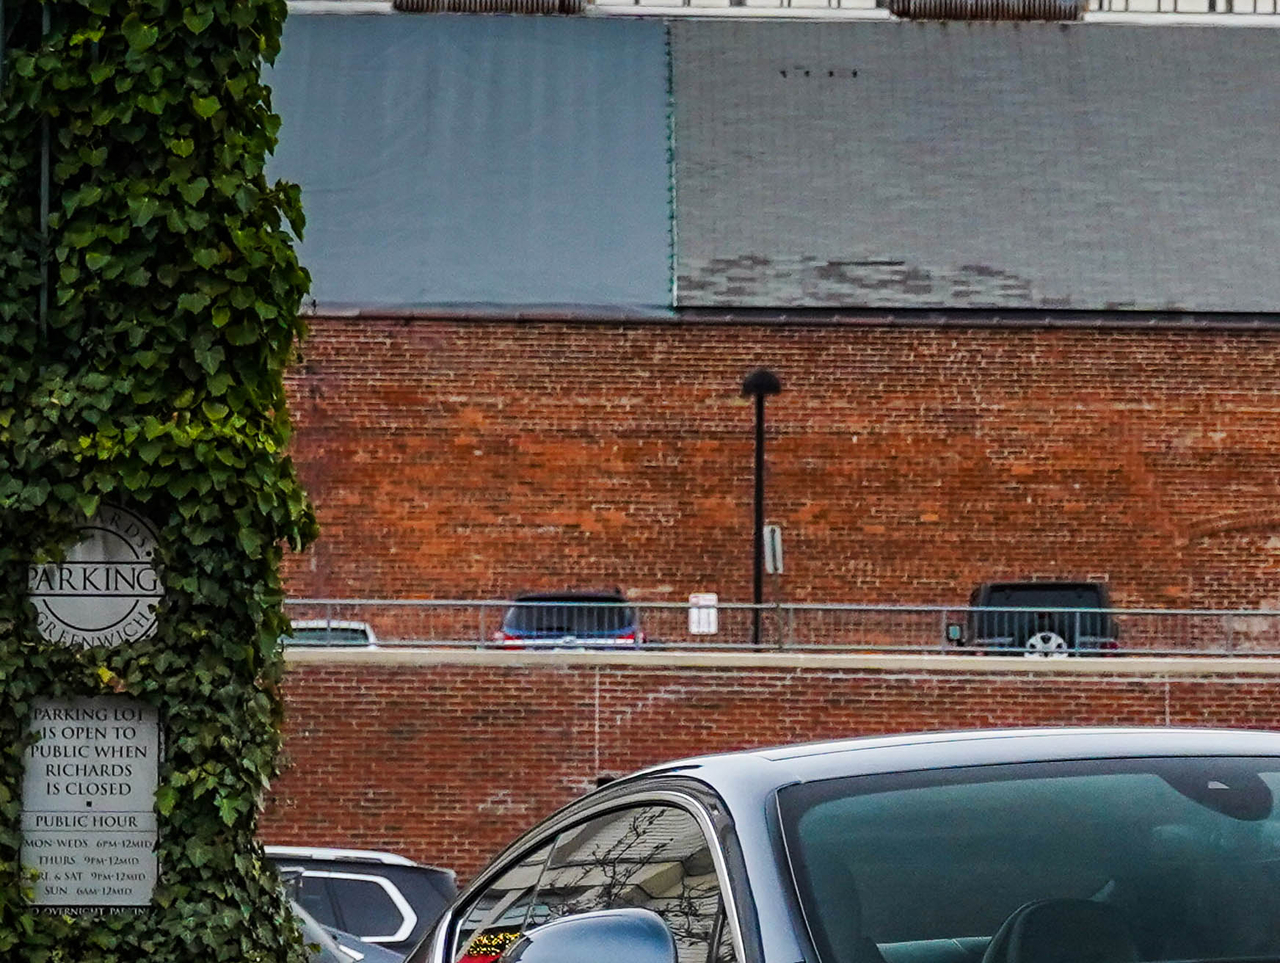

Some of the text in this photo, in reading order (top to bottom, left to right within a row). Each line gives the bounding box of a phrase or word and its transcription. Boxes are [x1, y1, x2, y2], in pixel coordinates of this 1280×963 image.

[28, 567, 158, 592] PARKING
[34, 708, 143, 721] PARKING LOT
[42, 727, 136, 740] IS OPEN TO
[30, 745, 147, 758] PUBLIC WHEN
[46, 764, 132, 777] RICHARDS
[47, 782, 132, 795] IS CLOSED
[35, 815, 138, 828] PUBLIC HOUR
[39, 856, 76, 866] THURS
[64, 872, 83, 881] SAT
[44, 886, 68, 896] SUN
